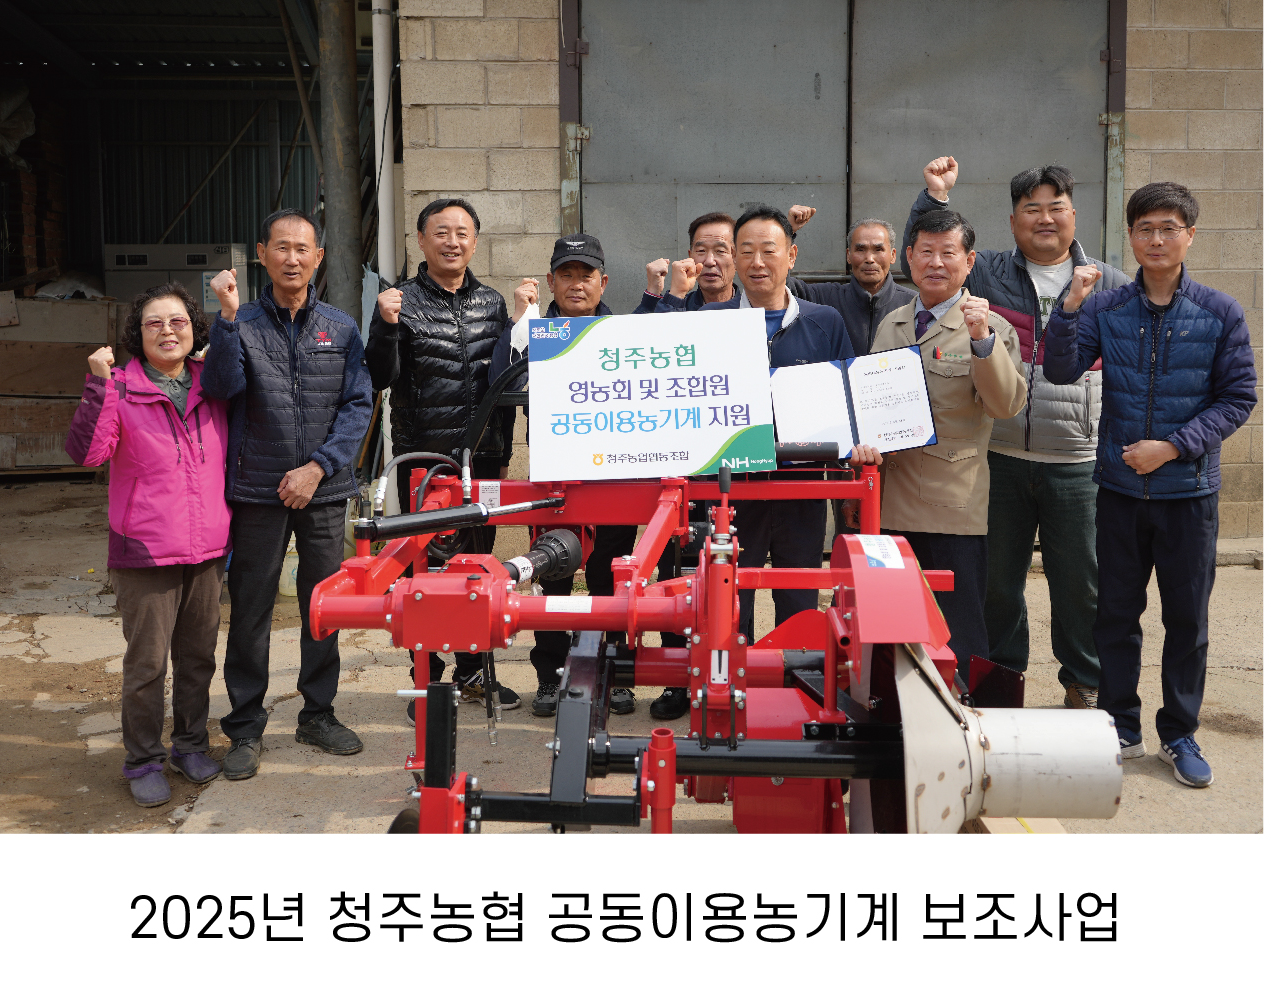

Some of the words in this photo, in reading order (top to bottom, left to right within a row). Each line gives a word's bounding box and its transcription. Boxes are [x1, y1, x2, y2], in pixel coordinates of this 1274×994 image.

[598, 344, 696, 372] 청주농협
[569, 379, 632, 404] 영농회
[639, 378, 660, 401] 및
[665, 374, 730, 399] 조합원
[550, 406, 701, 436] 공동이용농기계
[708, 403, 751, 427] 지원
[606, 450, 689, 465] 청주농업협동조합
[721, 456, 750, 469] NH
